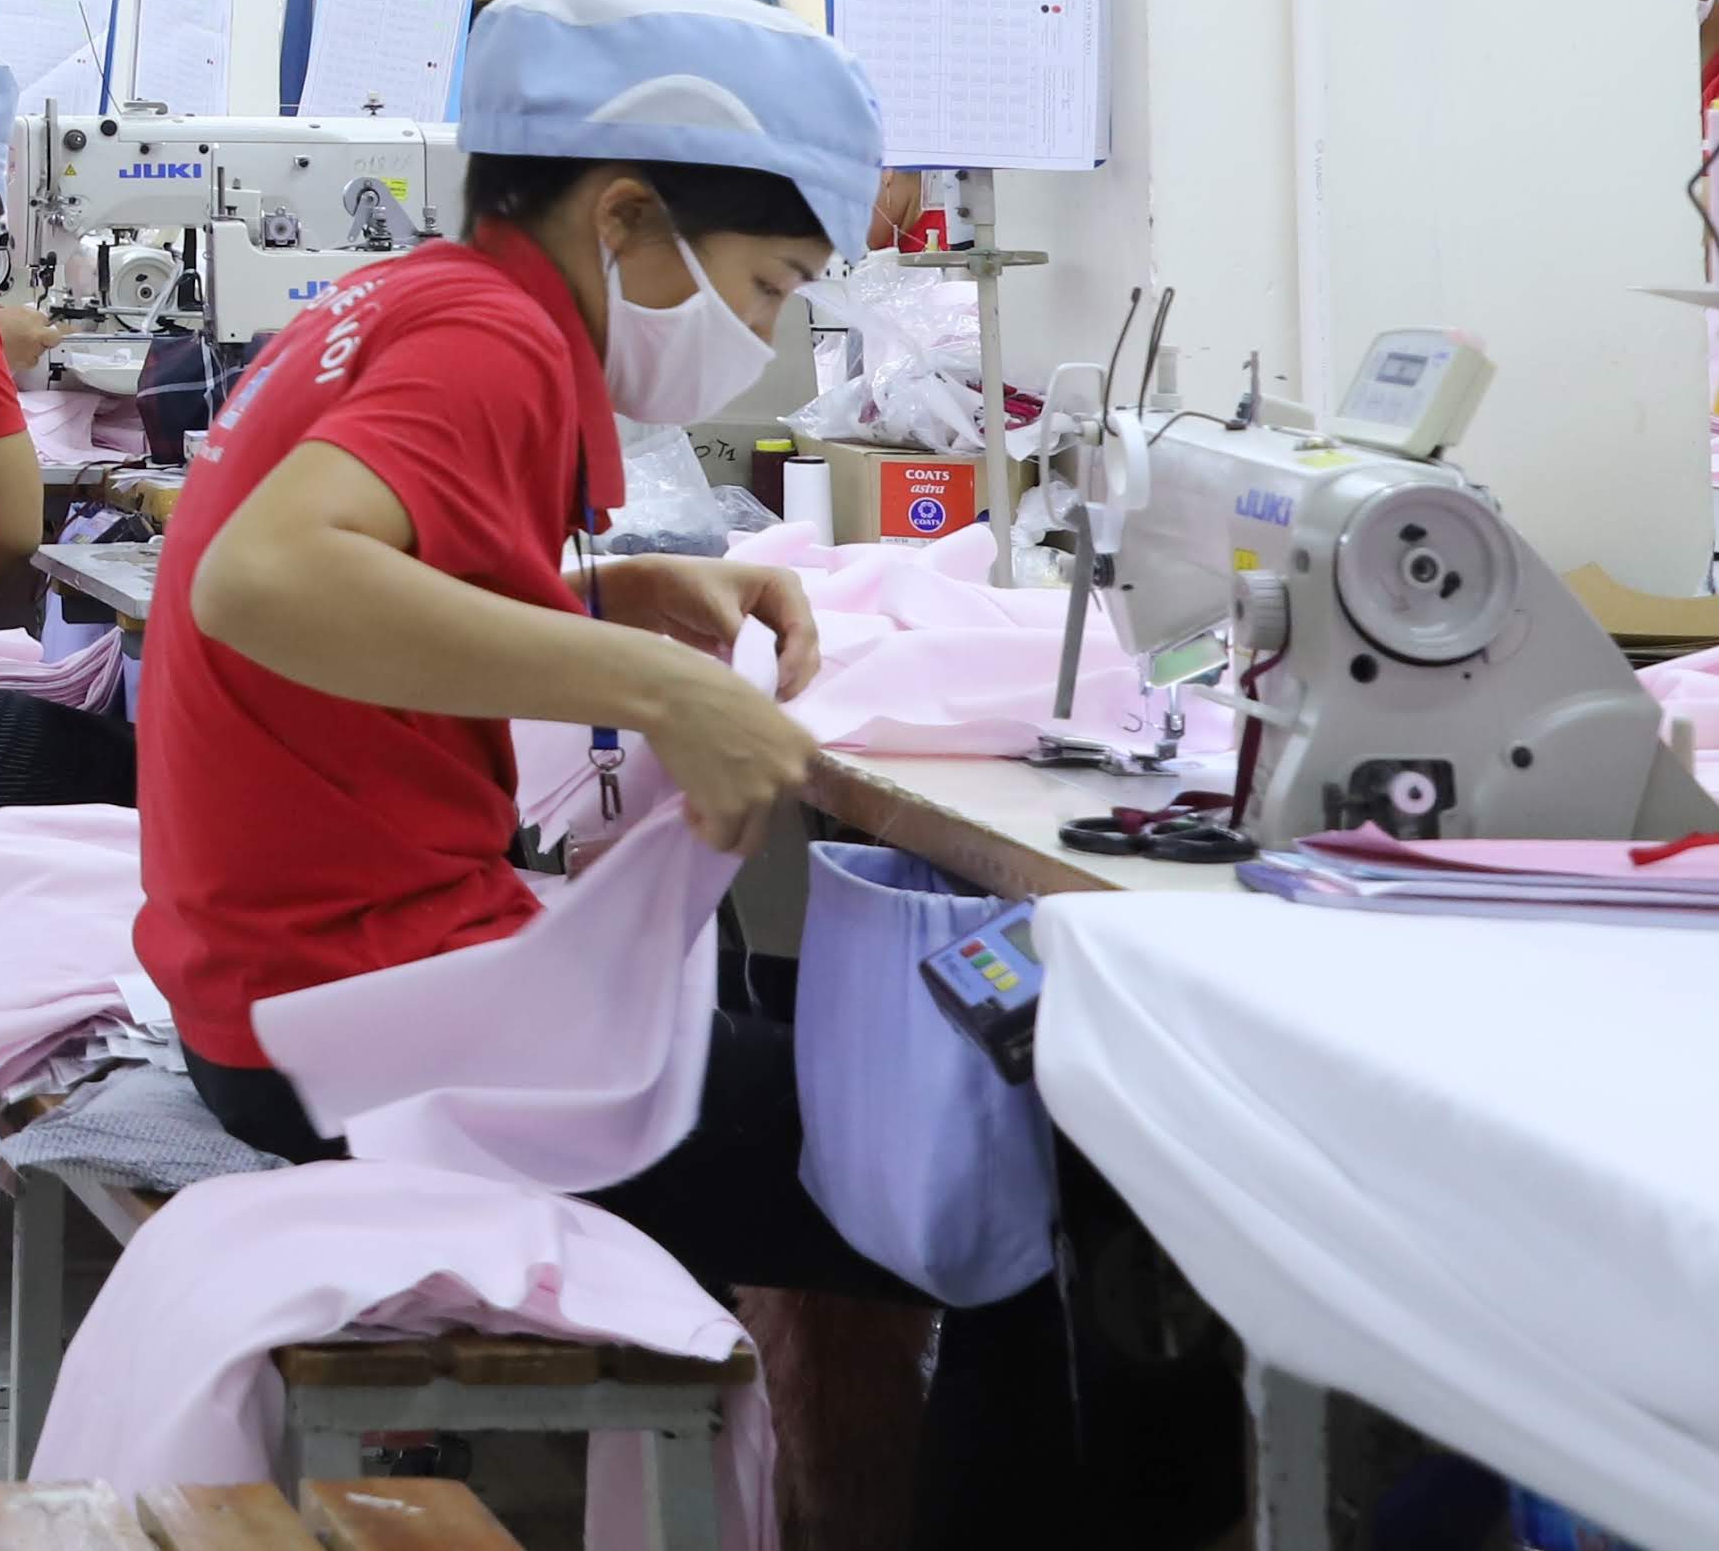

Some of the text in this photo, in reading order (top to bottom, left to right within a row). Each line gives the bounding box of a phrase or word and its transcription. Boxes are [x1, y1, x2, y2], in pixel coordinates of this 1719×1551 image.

[119, 162, 203, 179] JUKI
[905, 469, 951, 481] COATS
[910, 483, 945, 494] astra
[1235, 488, 1293, 527] JUKI
[913, 518, 940, 527] COATS
